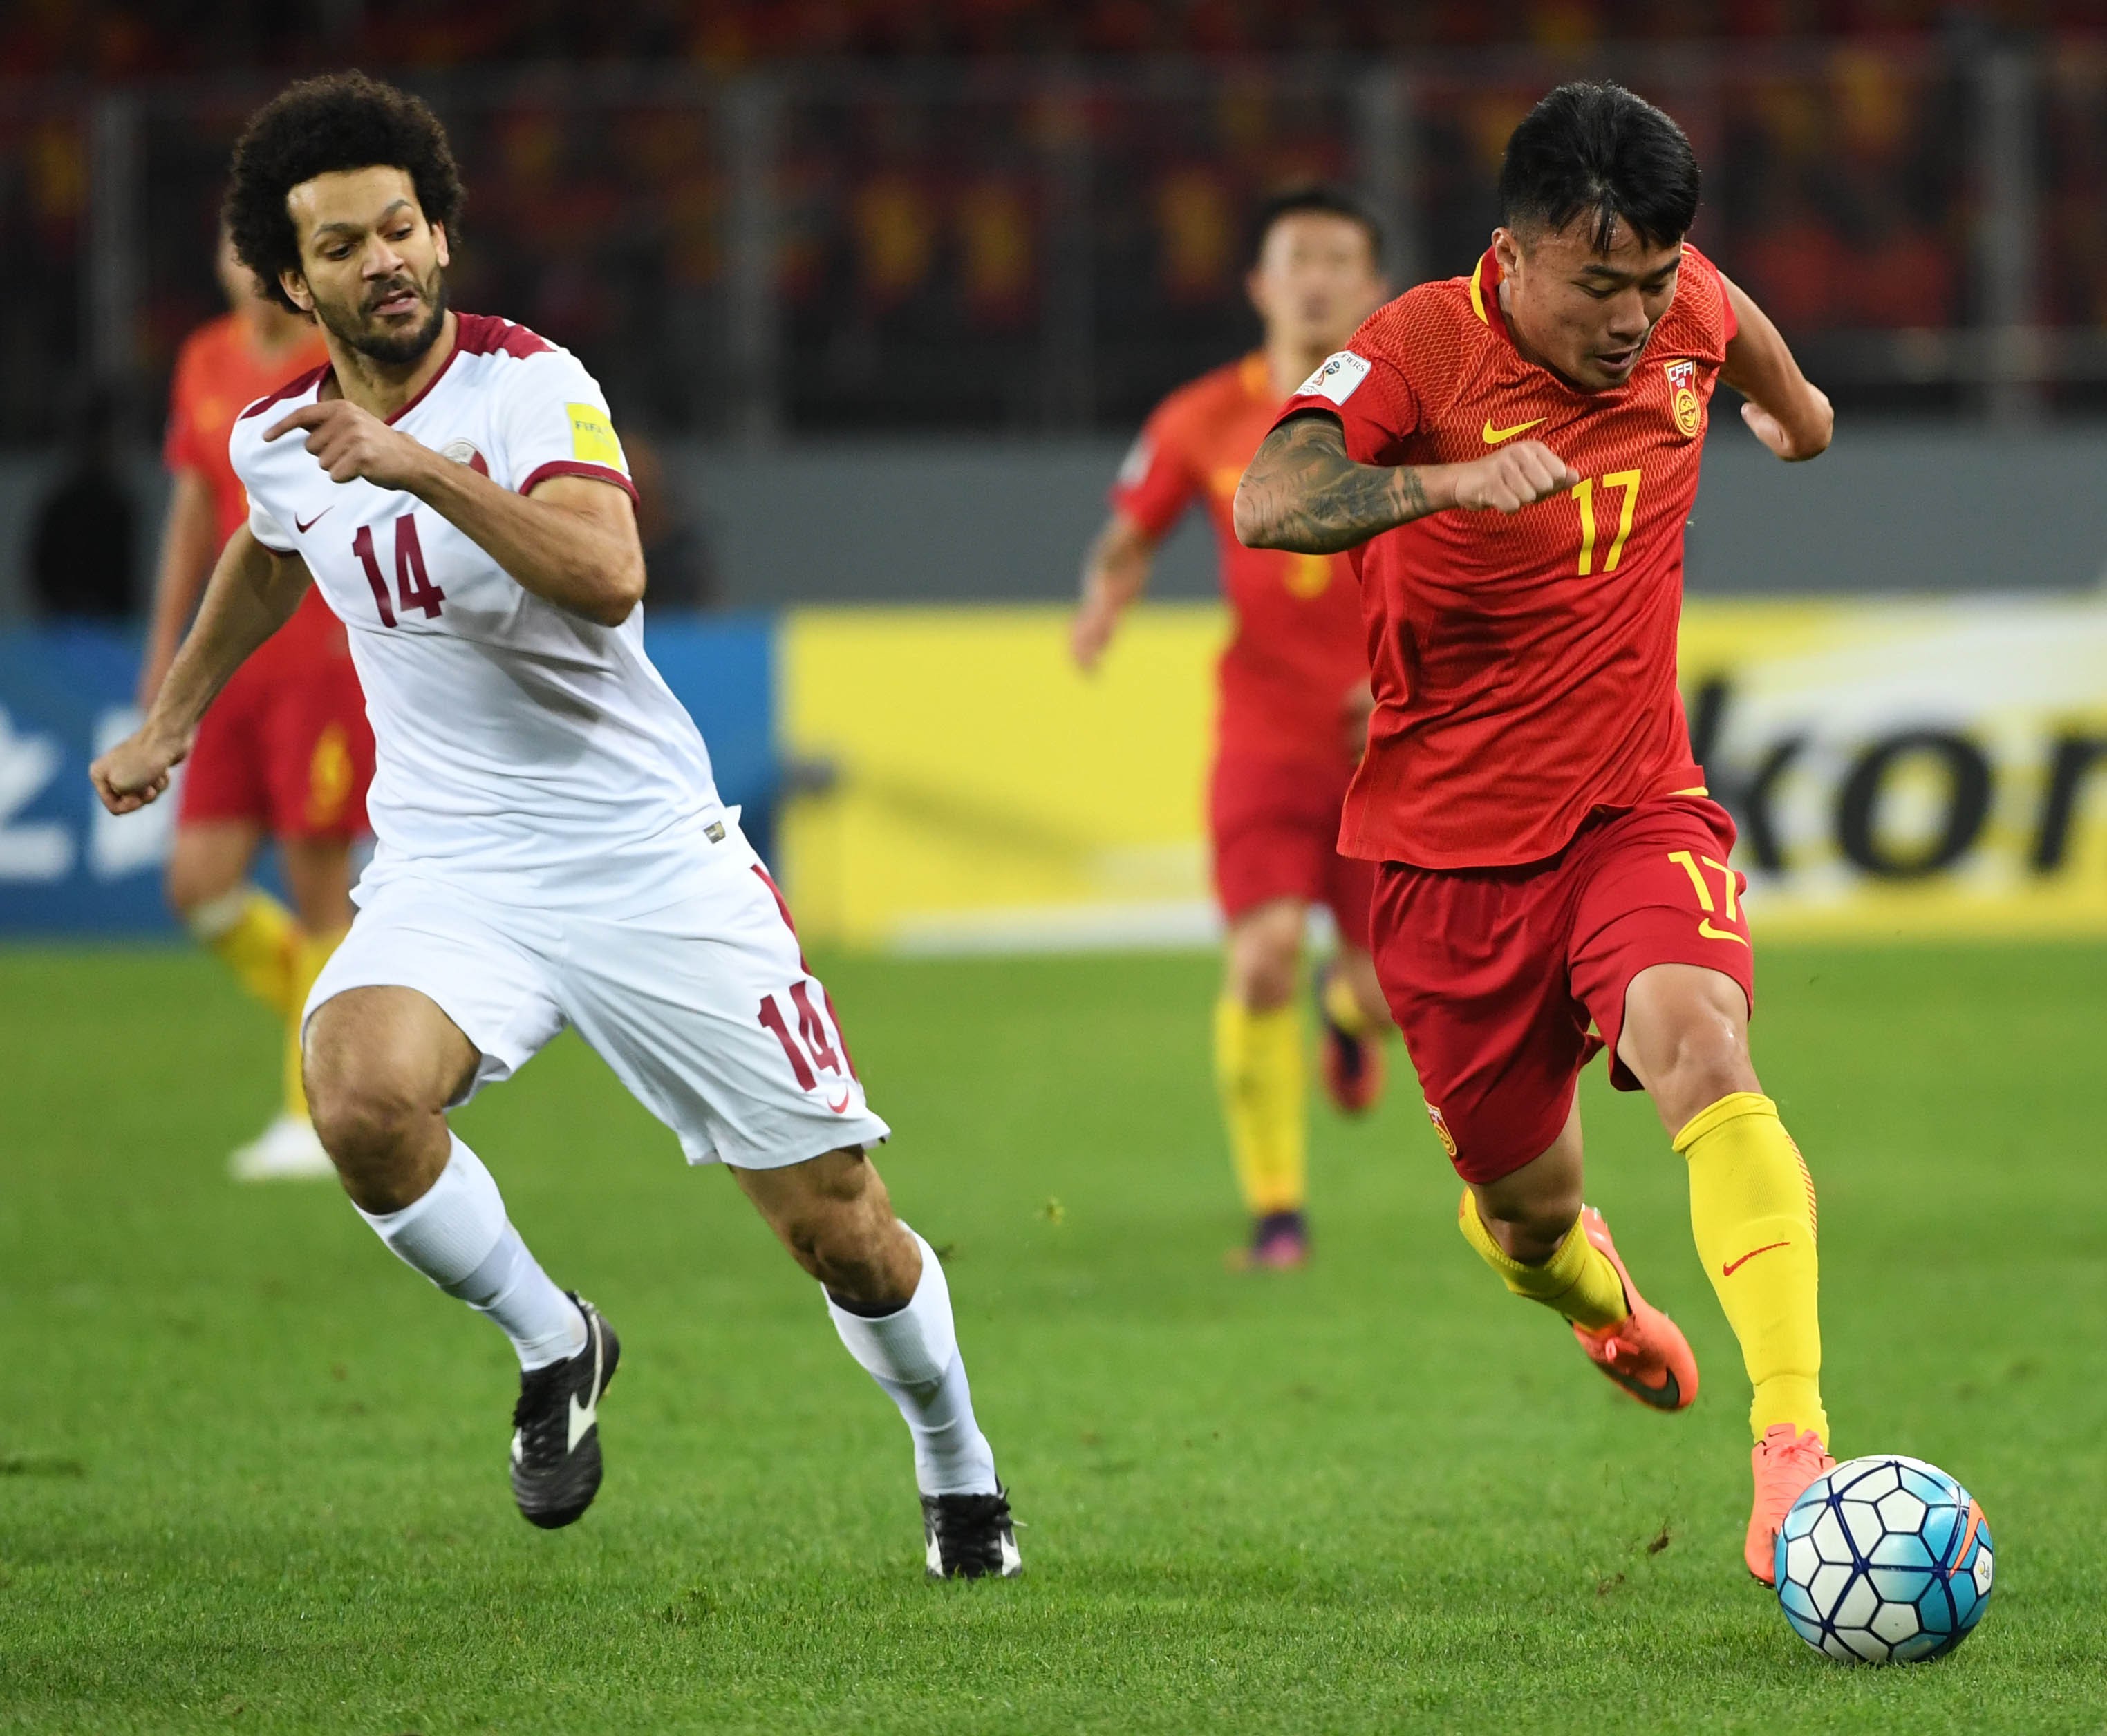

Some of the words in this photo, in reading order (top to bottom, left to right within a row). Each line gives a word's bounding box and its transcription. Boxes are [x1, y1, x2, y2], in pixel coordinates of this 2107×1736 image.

[1667, 361, 1693, 382] CFA
[352, 513, 446, 628] 14
[1571, 469, 1641, 576] 17
[1667, 851, 1737, 923] 17
[758, 980, 841, 1092] 14
